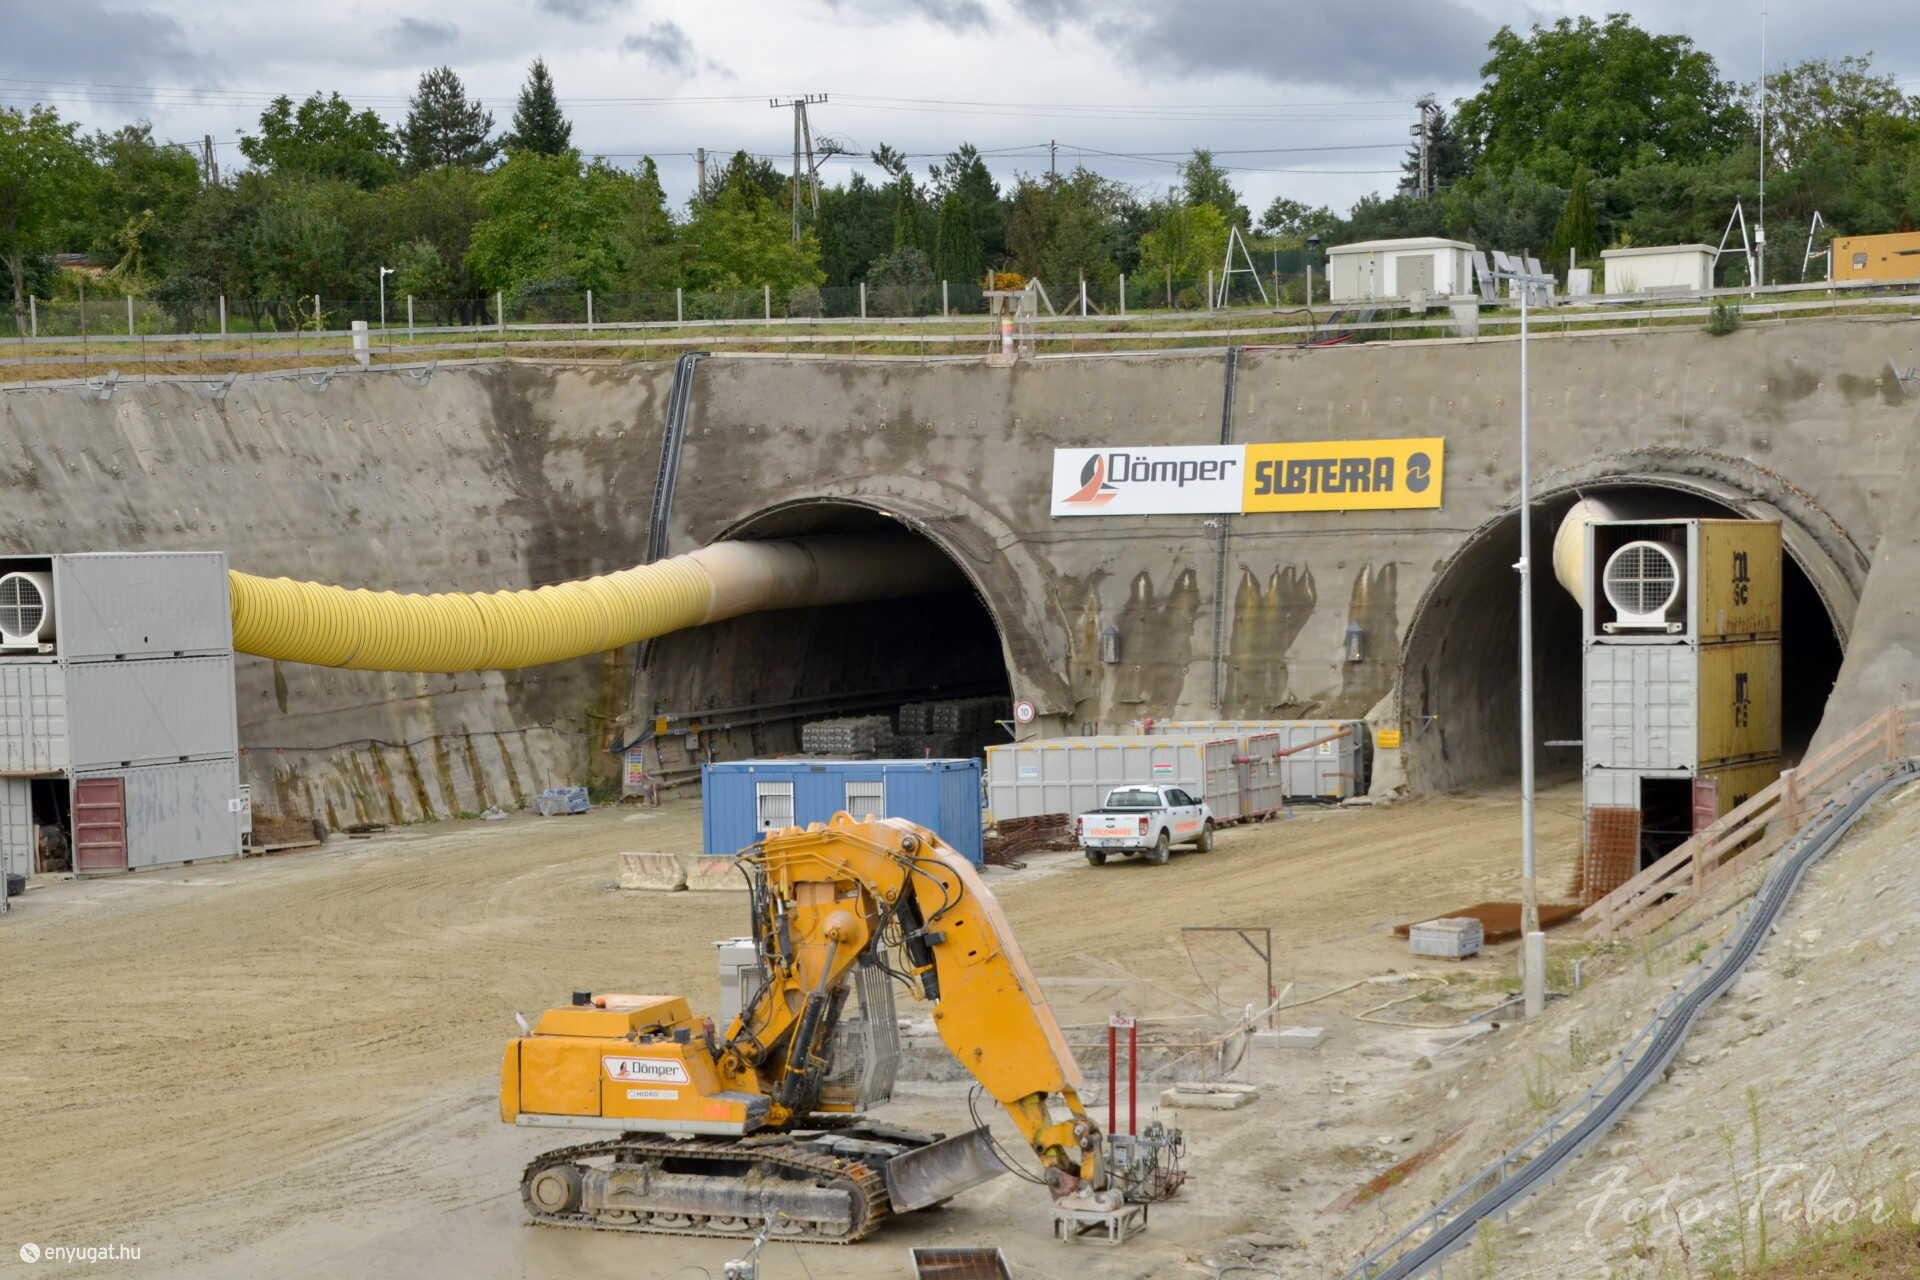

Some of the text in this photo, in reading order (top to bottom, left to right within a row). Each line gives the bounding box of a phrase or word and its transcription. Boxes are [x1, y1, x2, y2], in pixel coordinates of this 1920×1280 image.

[1107, 453, 1236, 488] Dömper
[1254, 457, 1395, 495] SUBTERRA
[1020, 707, 1030, 717] 10
[632, 1061, 679, 1077] Dömper
